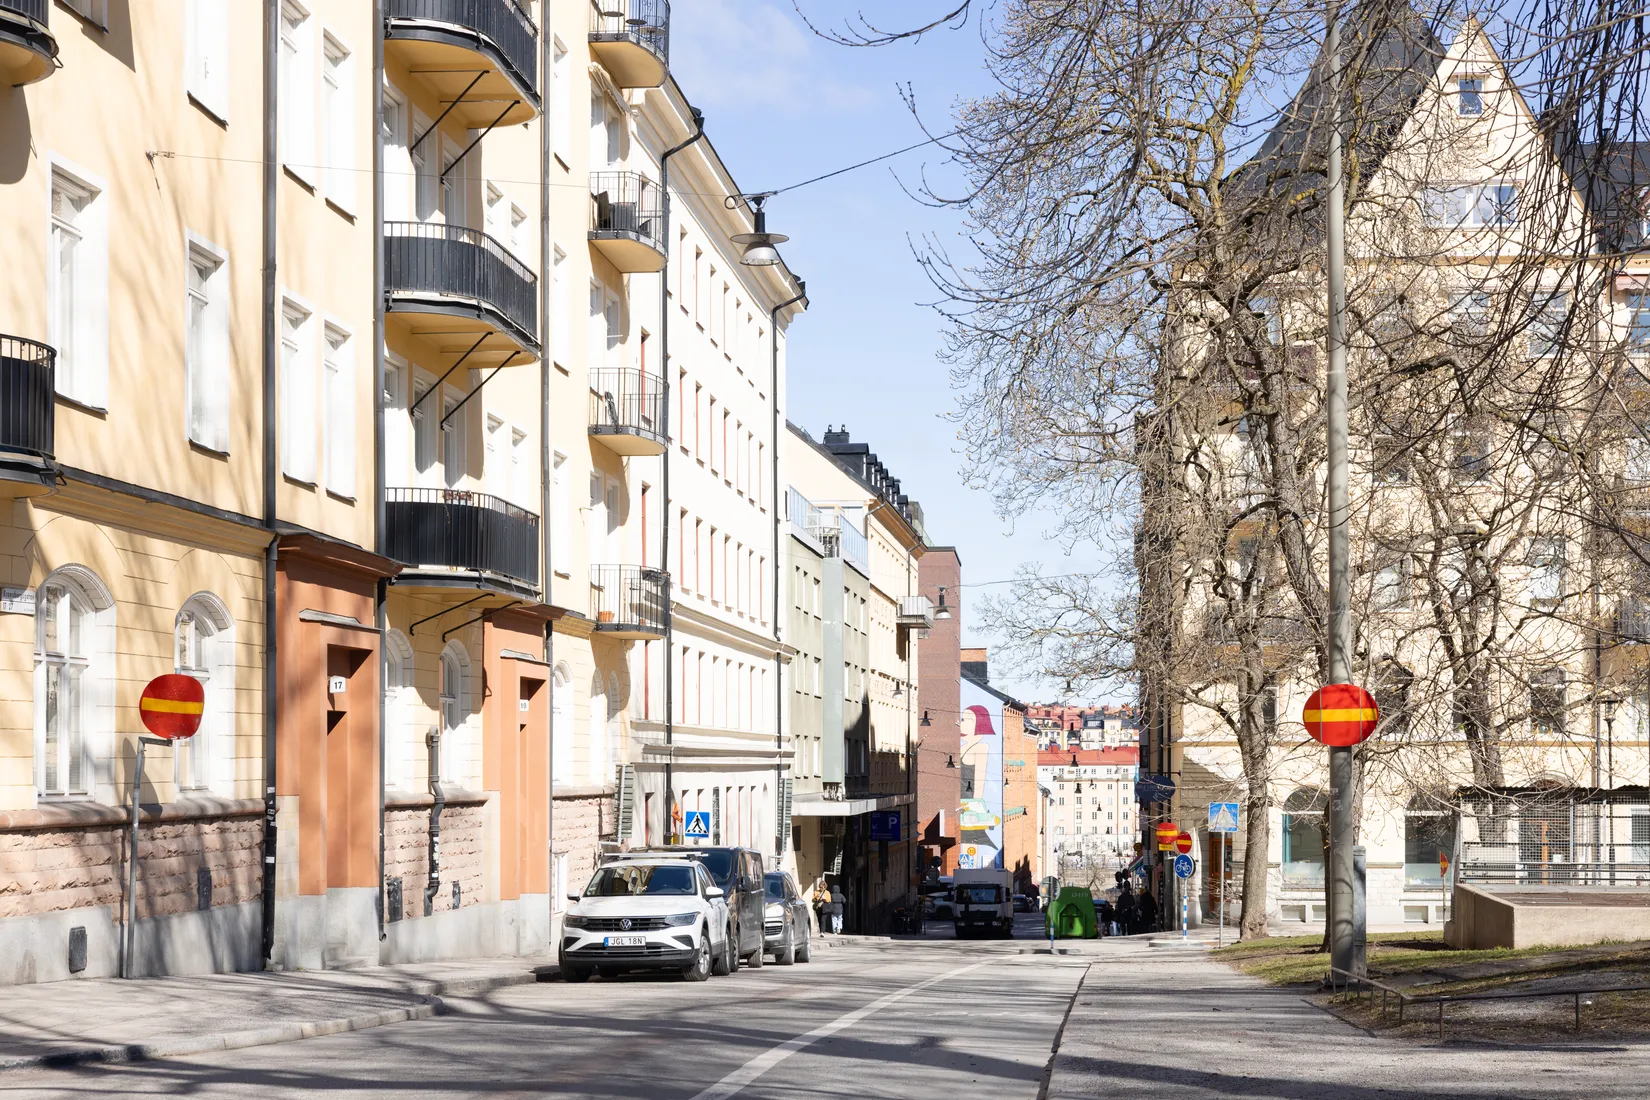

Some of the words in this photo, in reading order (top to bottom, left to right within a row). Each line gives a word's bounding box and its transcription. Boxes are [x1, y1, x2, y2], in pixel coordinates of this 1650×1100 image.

[334, 681, 343, 690] 17
[888, 816, 898, 830] P
[611, 937, 625, 945] JGL
[628, 937, 643, 945] 18N
